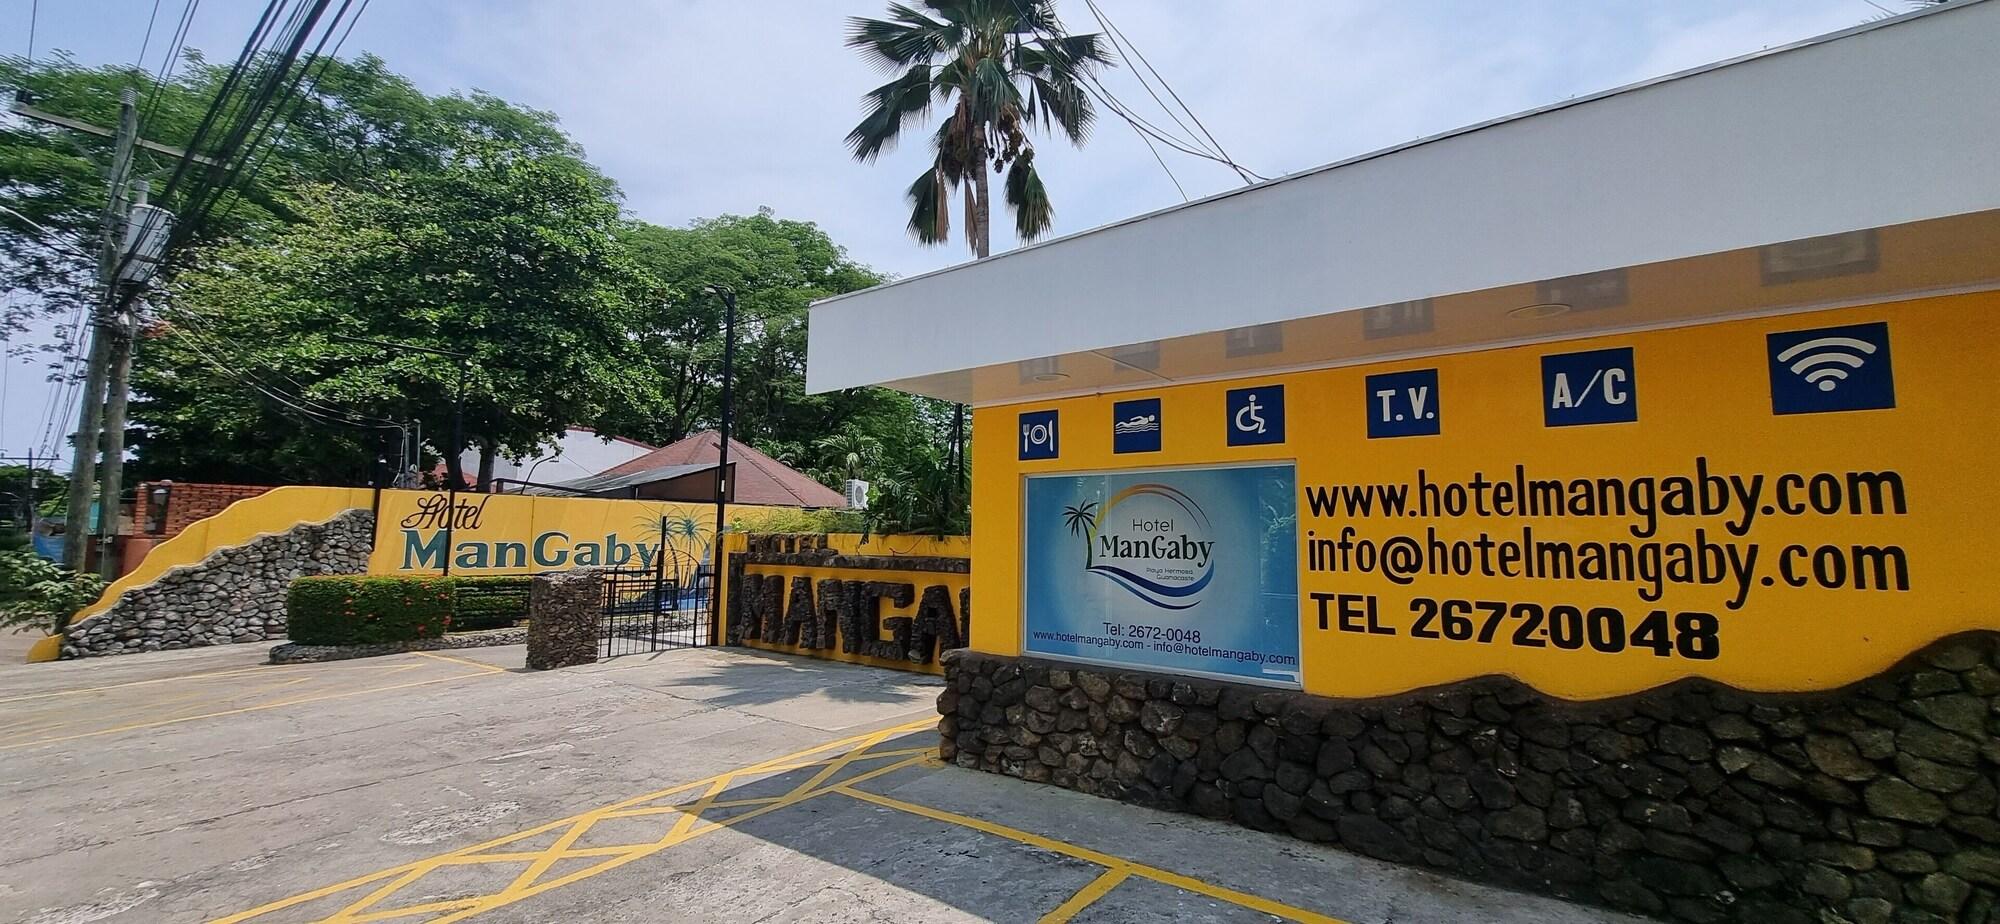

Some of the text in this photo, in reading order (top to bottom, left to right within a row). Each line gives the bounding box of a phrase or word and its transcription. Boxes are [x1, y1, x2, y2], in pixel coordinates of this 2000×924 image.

[1377, 386, 1434, 422] T.V.
[1552, 367, 1627, 409] A/C
[401, 494, 492, 530] Hotel
[1305, 456, 1907, 538] www.hotelmangaby.com
[1132, 519, 1174, 532] Hotel
[399, 530, 661, 578] ManGaby
[1099, 534, 1215, 568] ManGaby
[1307, 526, 1910, 611] info@hotelmangaby.com
[738, 573, 970, 665] MANGA
[1103, 622, 1201, 644] Tel: 2672-0048
[1310, 592, 1720, 660] TEL 2672-0048
[1033, 631, 1144, 649] www.hotelmangaby.com
[1153, 641, 1296, 665] info@hotelmangaby.com
